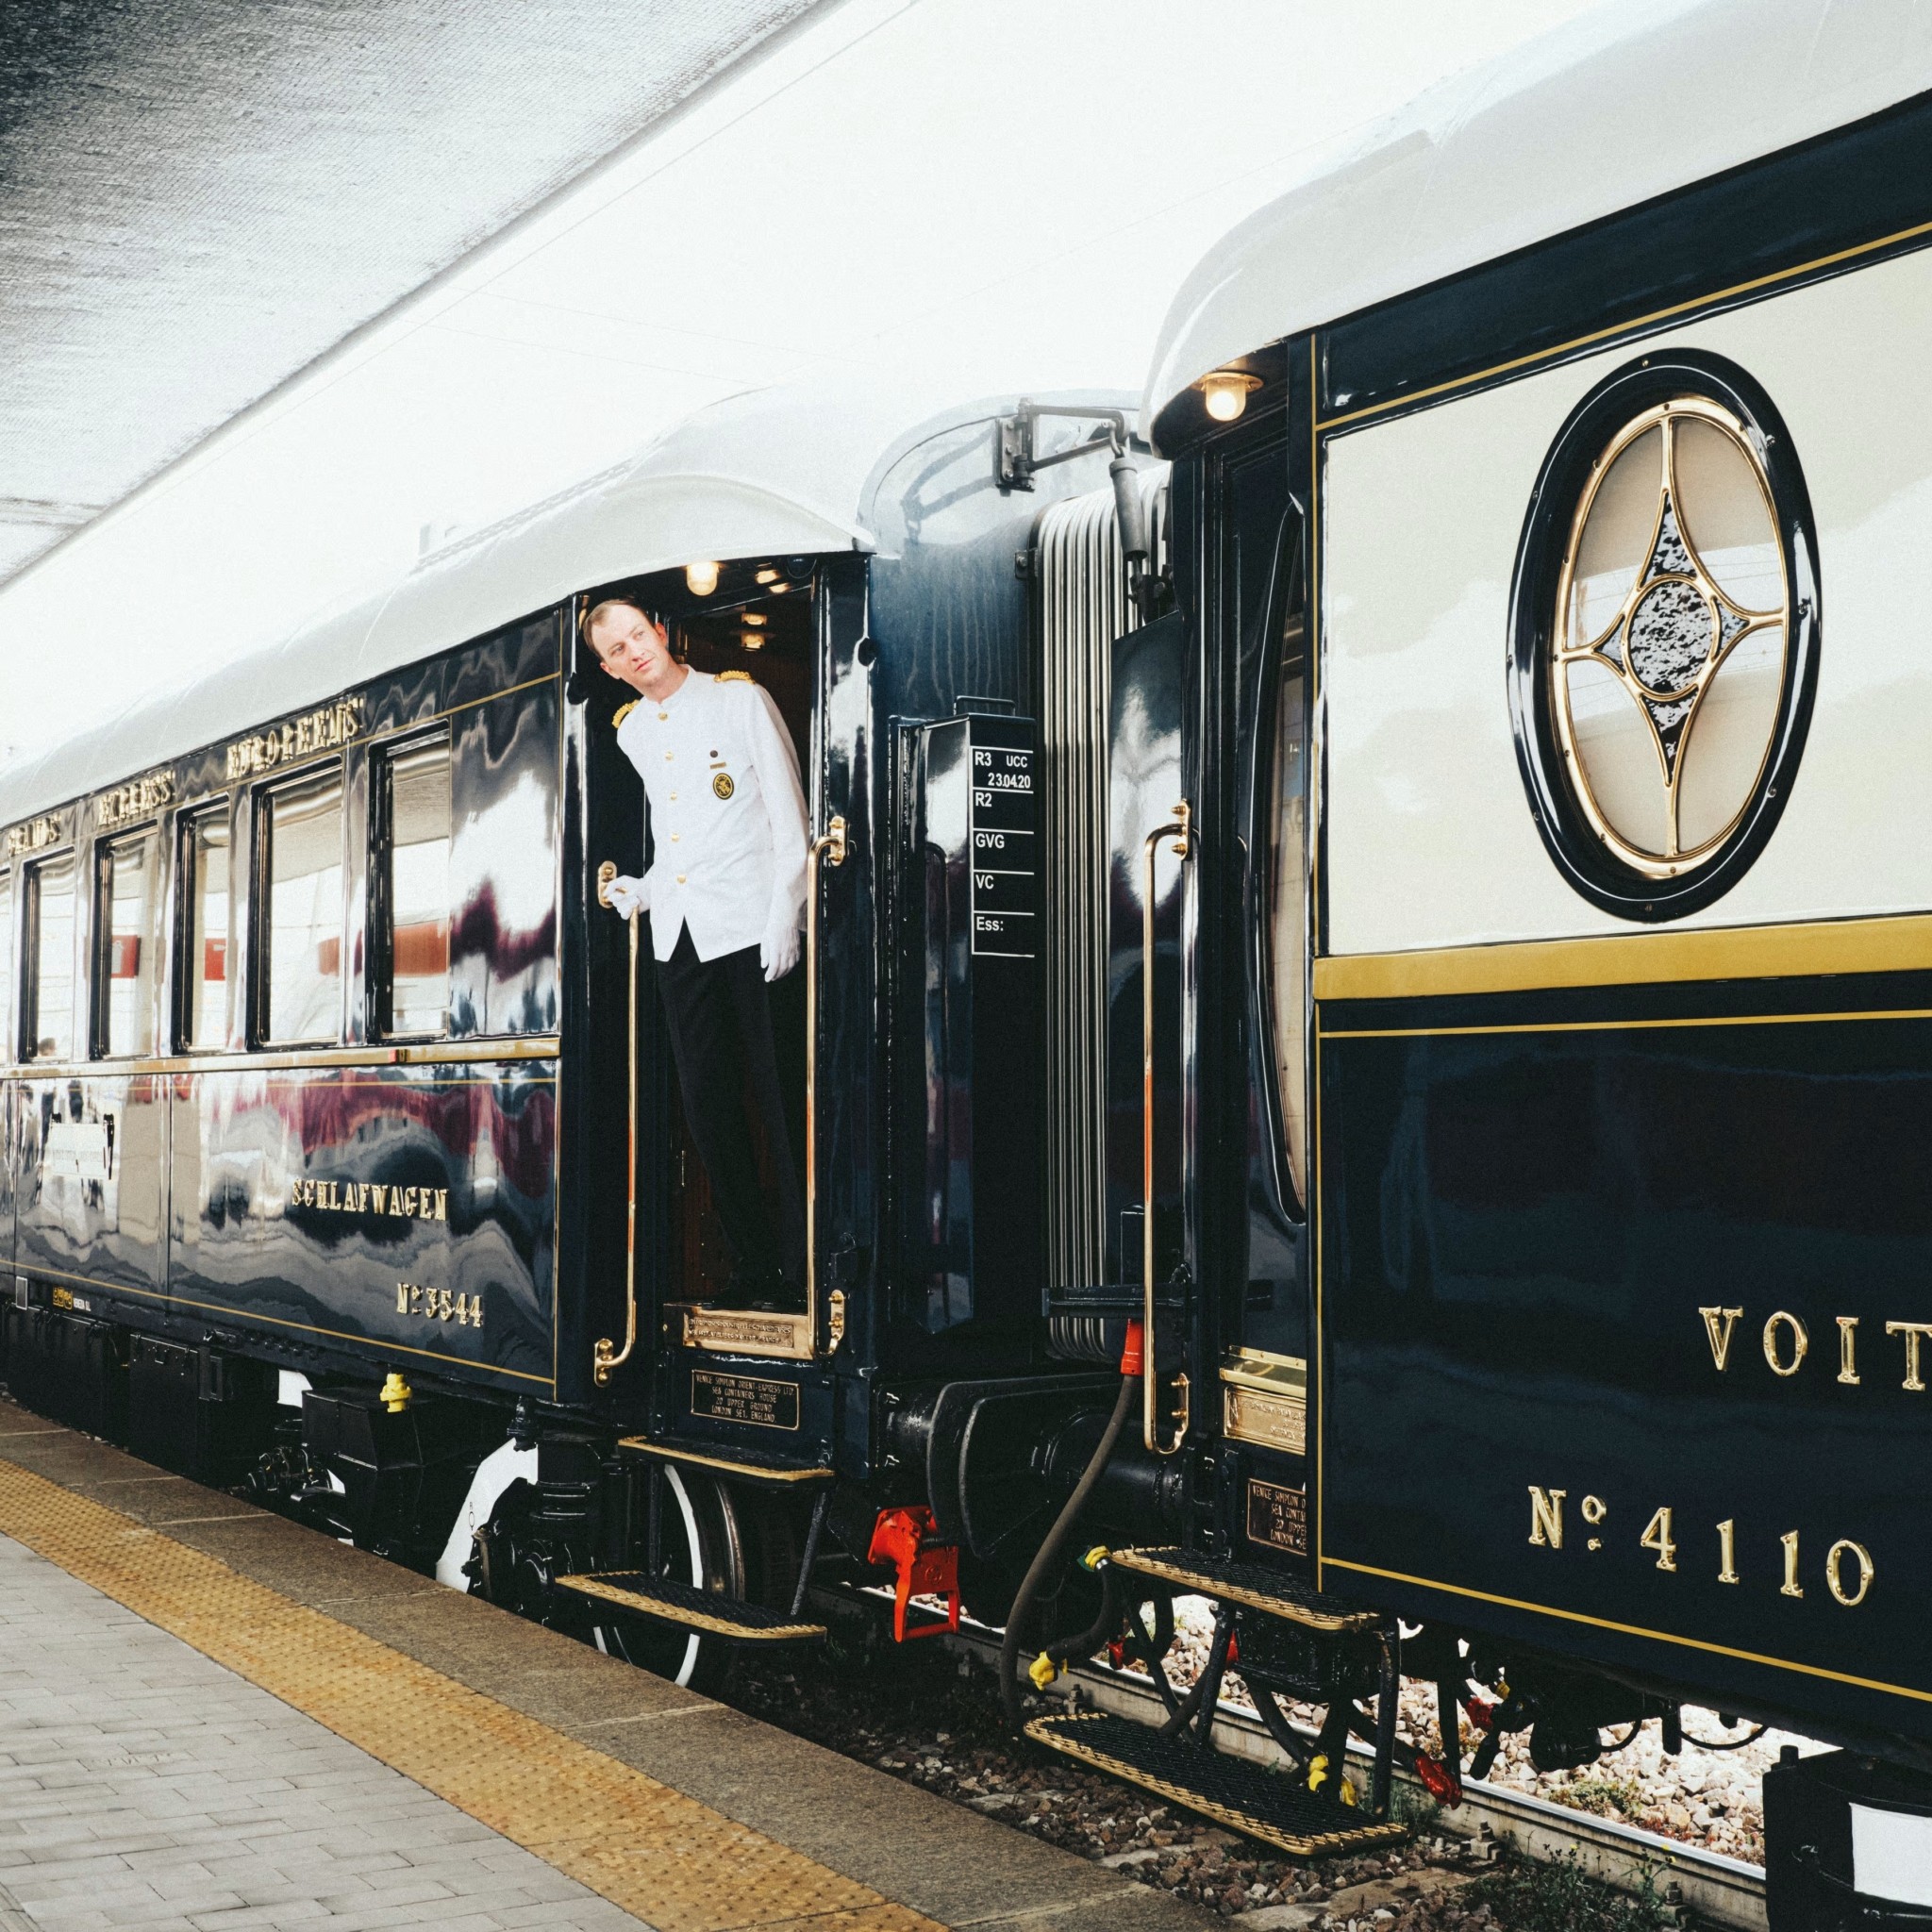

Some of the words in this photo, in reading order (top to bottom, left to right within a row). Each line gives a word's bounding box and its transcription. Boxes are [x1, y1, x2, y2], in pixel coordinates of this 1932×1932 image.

[974, 751, 991, 767] R3
[1006, 755, 1028, 768] UCC
[988, 772, 1031, 789] 23.04.20
[974, 791, 992, 808] R2
[975, 833, 1006, 849] GVG
[974, 874, 994, 890] VC
[976, 916, 1004, 932] Ess:
[291, 1178, 449, 1222] SCHLAFWAGEN
[425, 1287, 484, 1328] 3544
[1698, 1306, 1932, 1391] VOIT
[696, 1374, 712, 1385] VENICE
[715, 1376, 736, 1388] SIMPLON
[724, 1388, 755, 1400] CONTAINERS
[758, 1393, 777, 1404] HOUSE
[711, 1405, 732, 1415] LONDON
[727, 1398, 745, 1408] UPPER
[750, 1402, 773, 1412] GROUND
[1253, 1485, 1272, 1501] VENICE
[1274, 1491, 1299, 1507] SIMPLON
[1271, 1503, 1282, 1517] SEA
[1274, 1518, 1285, 1530] 20
[1270, 1528, 1294, 1546] LONDON
[1640, 1507, 1874, 1607] 4110
